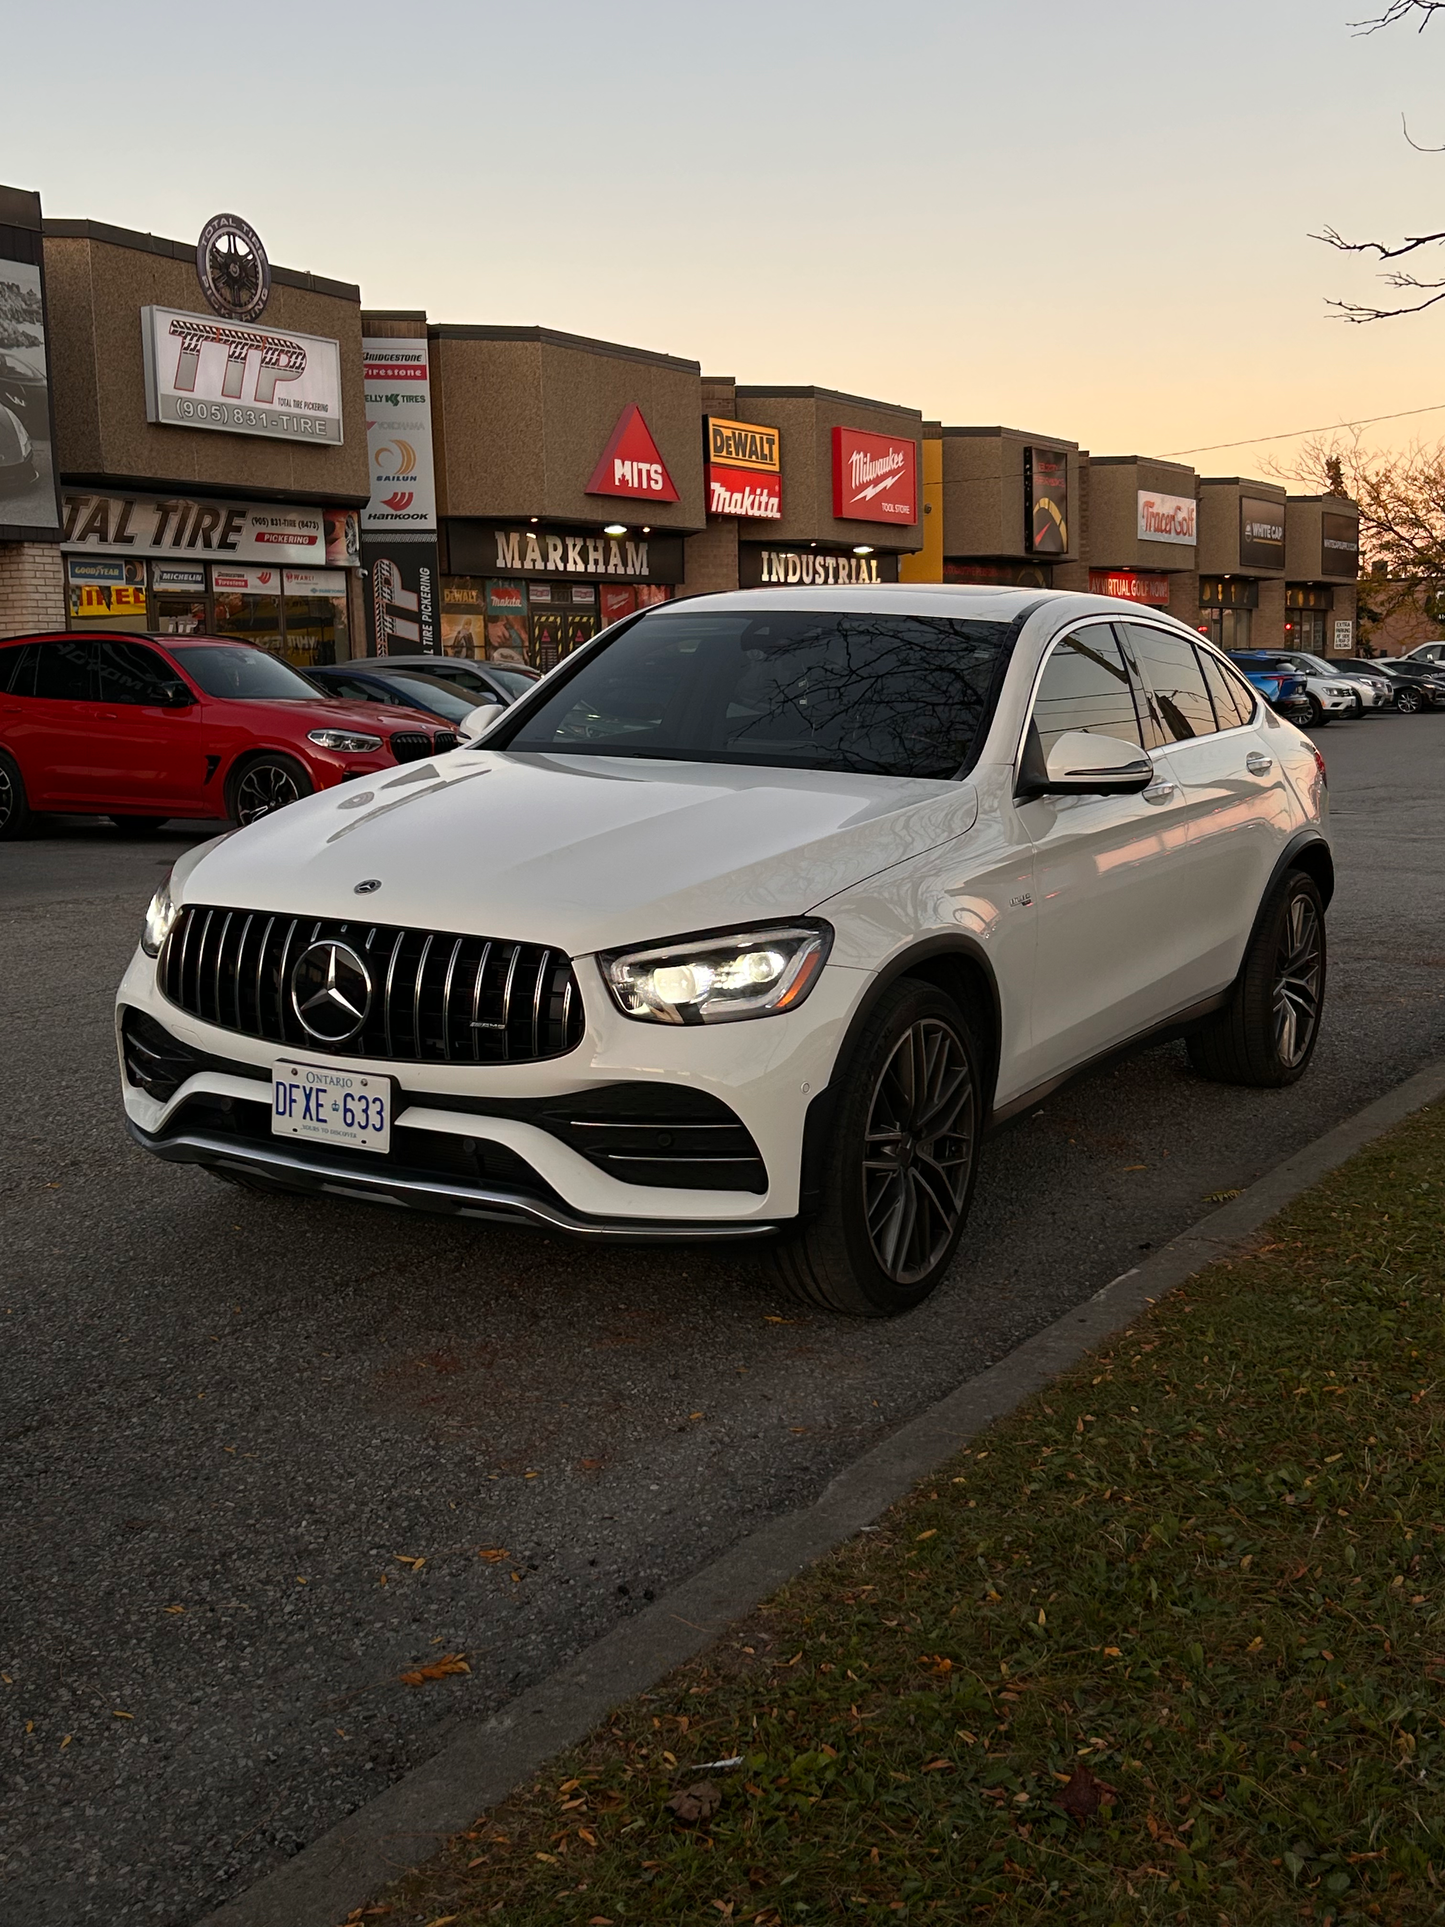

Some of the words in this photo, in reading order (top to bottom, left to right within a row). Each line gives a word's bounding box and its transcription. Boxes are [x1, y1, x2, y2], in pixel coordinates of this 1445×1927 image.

[201, 217, 236, 247] TOTAL
[241, 223, 266, 261] TIRE
[169, 319, 307, 404] TTP
[277, 397, 292, 409] TOTAL
[293, 399, 302, 409] TIRE
[304, 401, 329, 413] PICKERING
[401, 394, 426, 403] TIRES
[176, 398, 228, 423] (905)
[233, 408, 327, 435] 831-TIRE
[614, 459, 663, 490] MITS
[848, 447, 905, 490] Milwaukee
[881, 502, 895, 513] TOOL
[895, 504, 910, 514] STORE
[150, 500, 249, 552] TIRE
[251, 516, 269, 528] (905)
[270, 517, 297, 529] 831-TIRE
[298, 519, 320, 531] (8473)
[1252, 522, 1271, 539] WHITE
[1271, 526, 1283, 540] CAP
[264, 534, 309, 545] PICKERING
[494, 531, 649, 576] MARKHAM
[75, 565, 119, 577] GOODYEAR
[162, 572, 203, 582] MICHELIN
[761, 551, 881, 585] INDUSTRIAL
[419, 567, 432, 622] PICKERING
[1101, 578, 1131, 596] VIRTUAL
[1131, 580, 1149, 597] GOLF
[422, 624, 434, 645] TIRE
[275, 1081, 327, 1124] DFXE
[343, 1092, 384, 1132] 633
[301, 1124, 320, 1133] YOURS
[330, 1129, 357, 1139] DISCOVER
